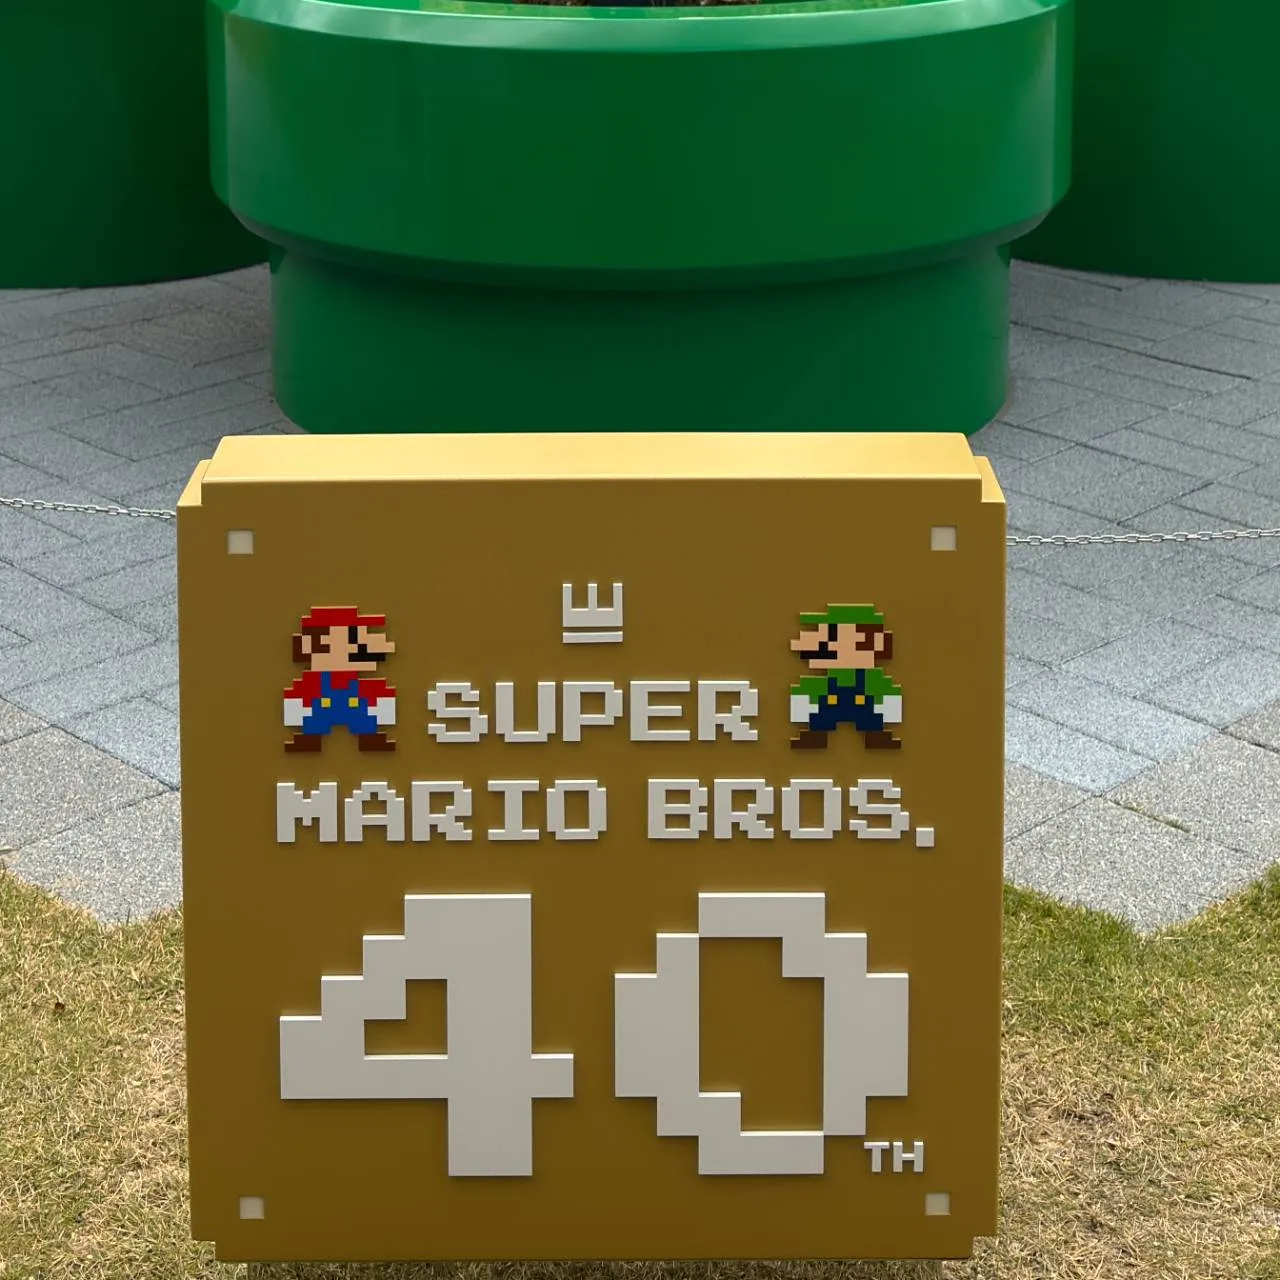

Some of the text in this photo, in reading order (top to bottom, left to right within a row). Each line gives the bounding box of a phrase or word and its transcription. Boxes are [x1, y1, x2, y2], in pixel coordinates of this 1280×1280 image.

[427, 680, 759, 743] SUPER
[276, 778, 935, 848] MARIO BROS.
[279, 891, 924, 1177] 40 TH
